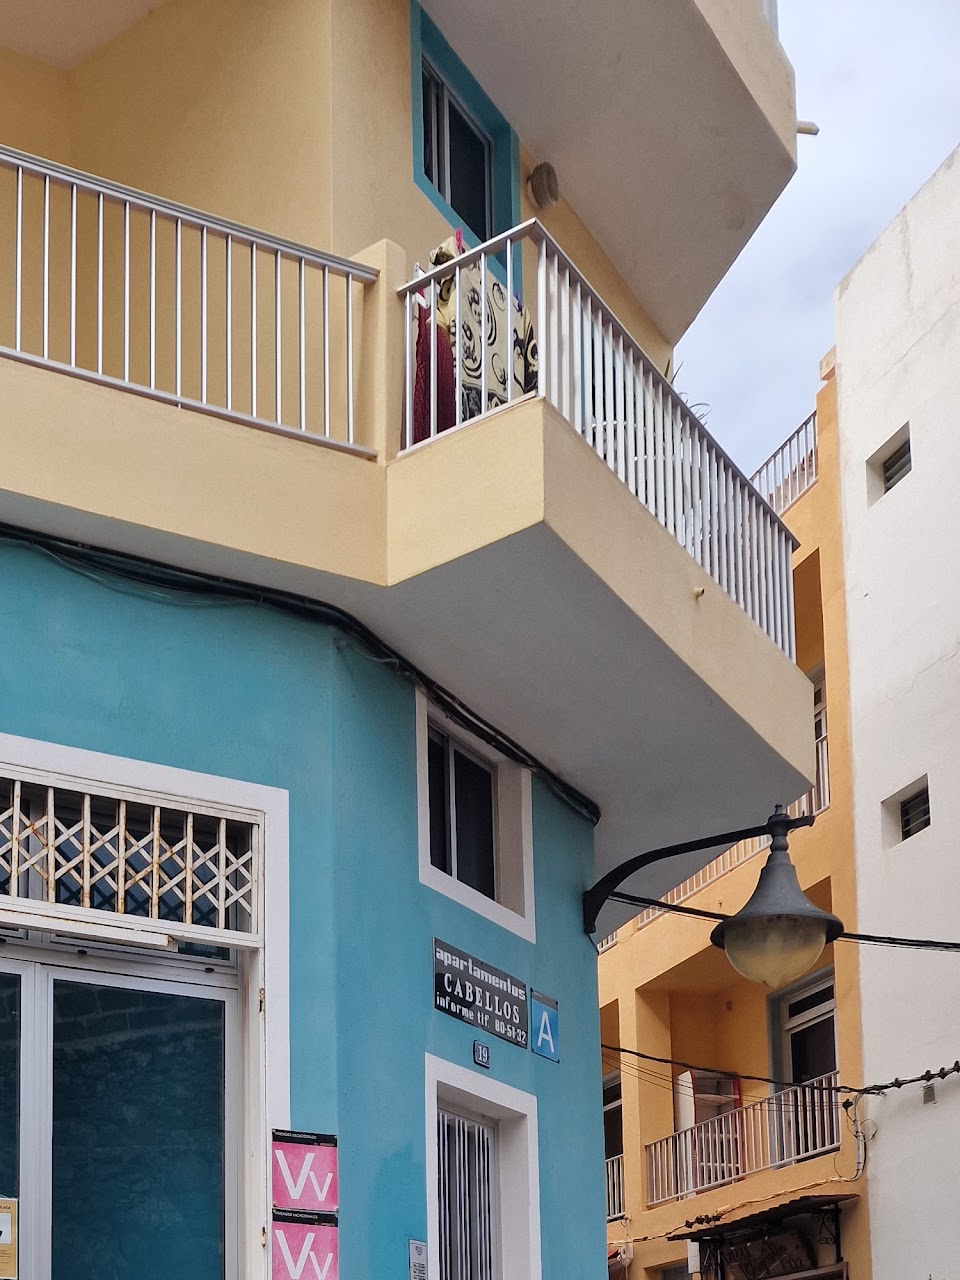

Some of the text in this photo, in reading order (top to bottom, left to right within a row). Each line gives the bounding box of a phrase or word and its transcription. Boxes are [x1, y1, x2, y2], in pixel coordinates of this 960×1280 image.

[436, 947, 526, 1000] apartamentos
[437, 992, 474, 1020] informe
[444, 973, 519, 1024] CABELLOS
[537, 1011, 555, 1053] A
[478, 1045, 488, 1062] 19
